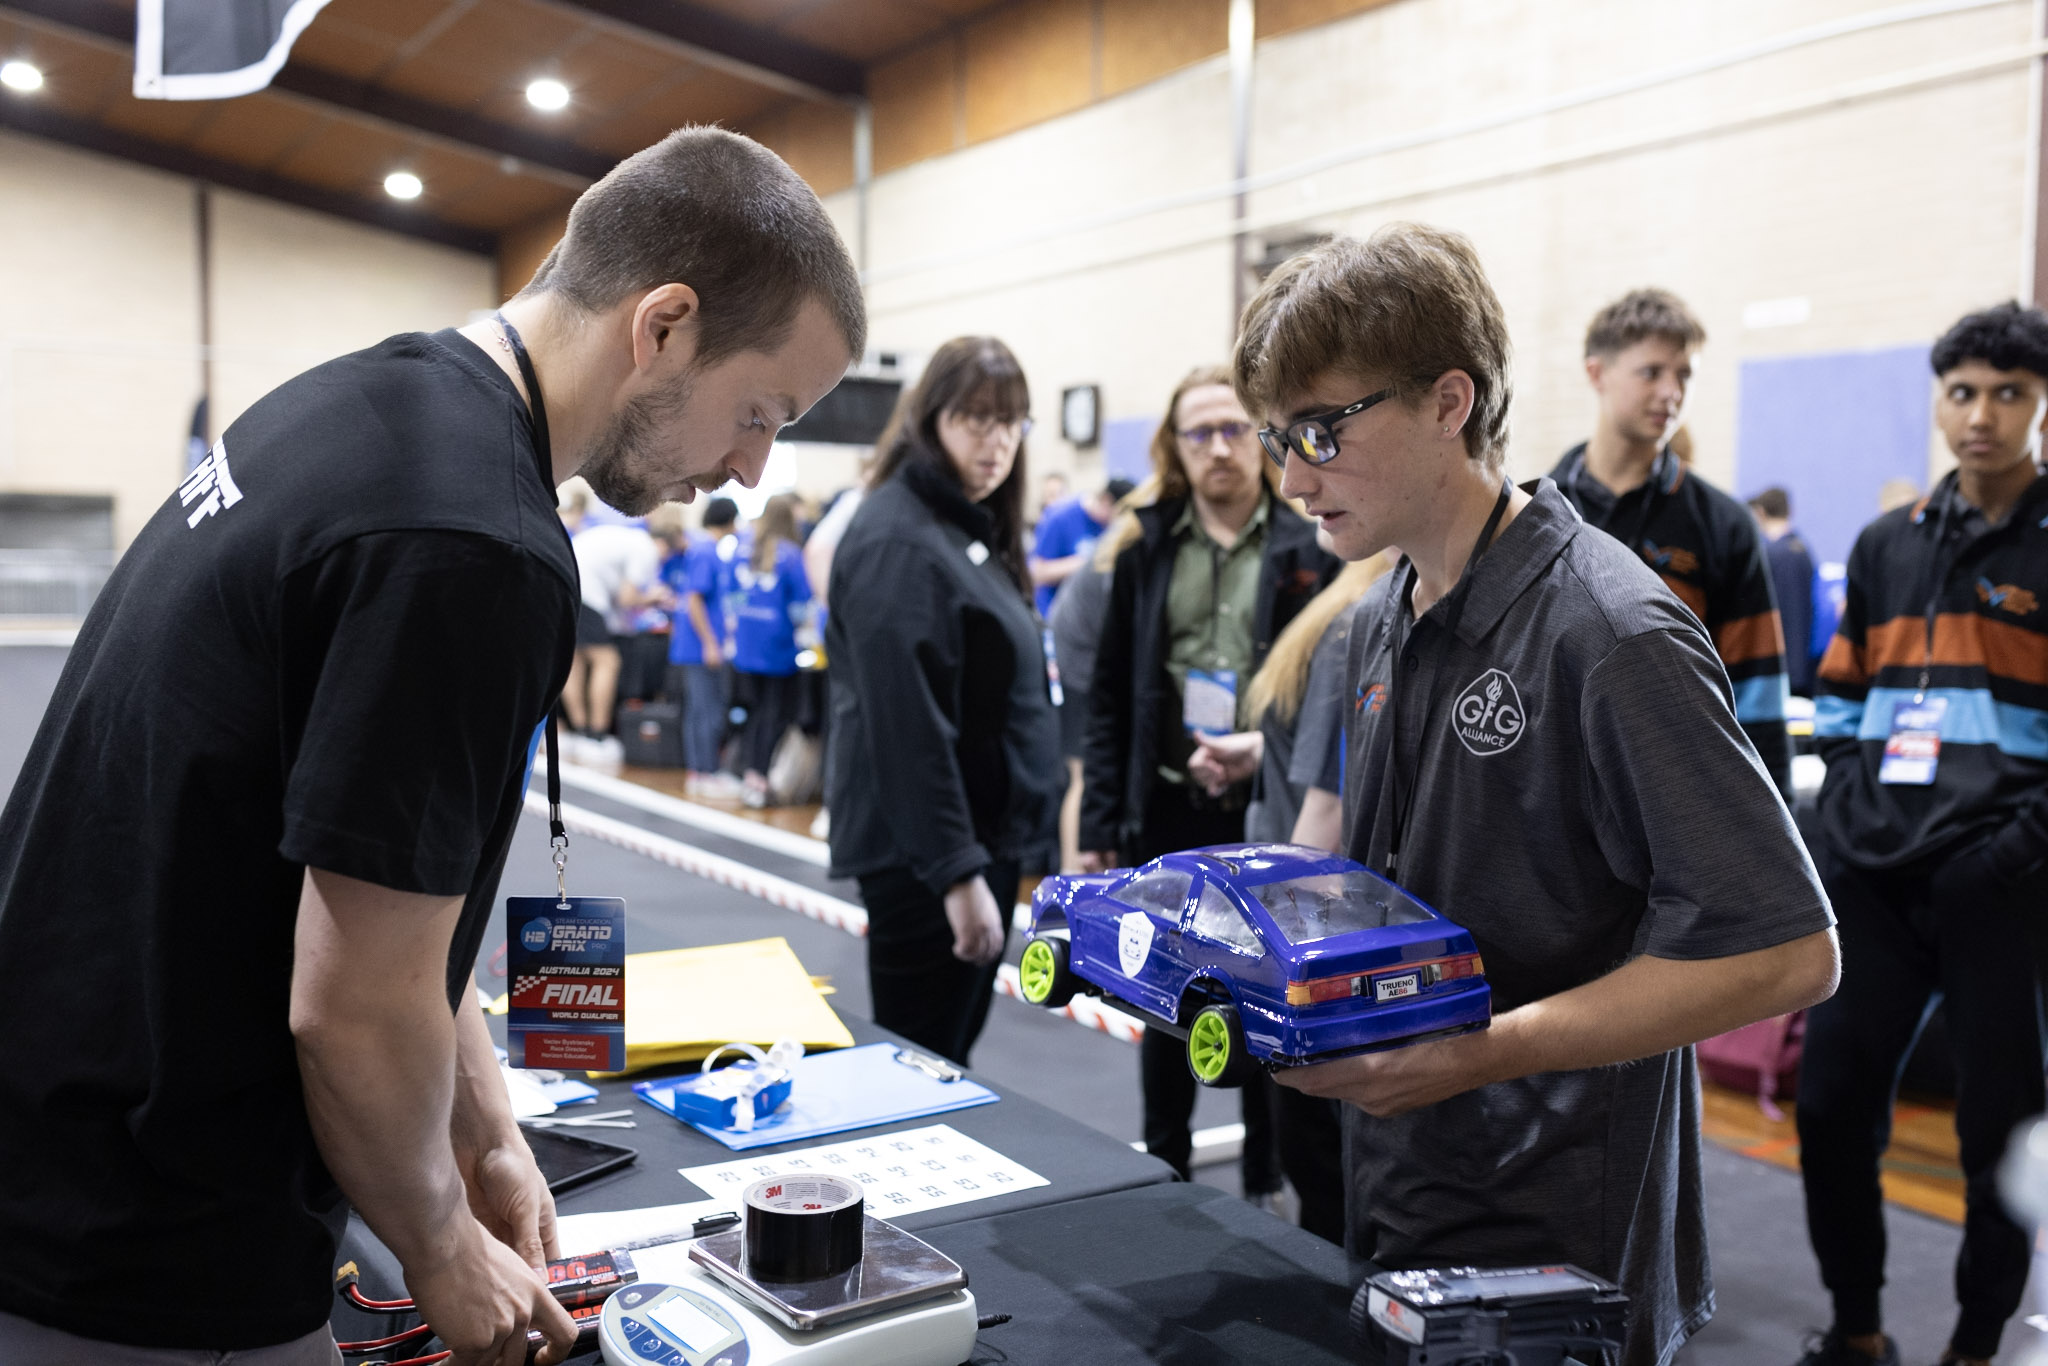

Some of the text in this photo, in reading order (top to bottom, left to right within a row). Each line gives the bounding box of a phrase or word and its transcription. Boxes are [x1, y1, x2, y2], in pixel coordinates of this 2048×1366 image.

[1461, 726, 1506, 748] ALLIANCE
[525, 931, 546, 943] H2
[552, 925, 612, 940] GRAND
[551, 940, 586, 952] PRIX
[538, 966, 620, 976] AUSTRALIA 2024
[1381, 979, 1414, 991] TRUENO
[541, 983, 619, 1006] FINAL
[1388, 987, 1408, 997] AE86
[552, 1011, 619, 1020] WORLD QUALIFIER
[920, 1160, 946, 1171] 53
[953, 1178, 981, 1190] 53
[987, 1172, 1014, 1183] 52
[765, 1185, 782, 1199] 3M
[852, 1172, 879, 1184] 56
[883, 1192, 912, 1204] 56
[918, 1185, 947, 1197] 55
[548, 1262, 587, 1283] 00
[587, 1266, 611, 1276] mAh
